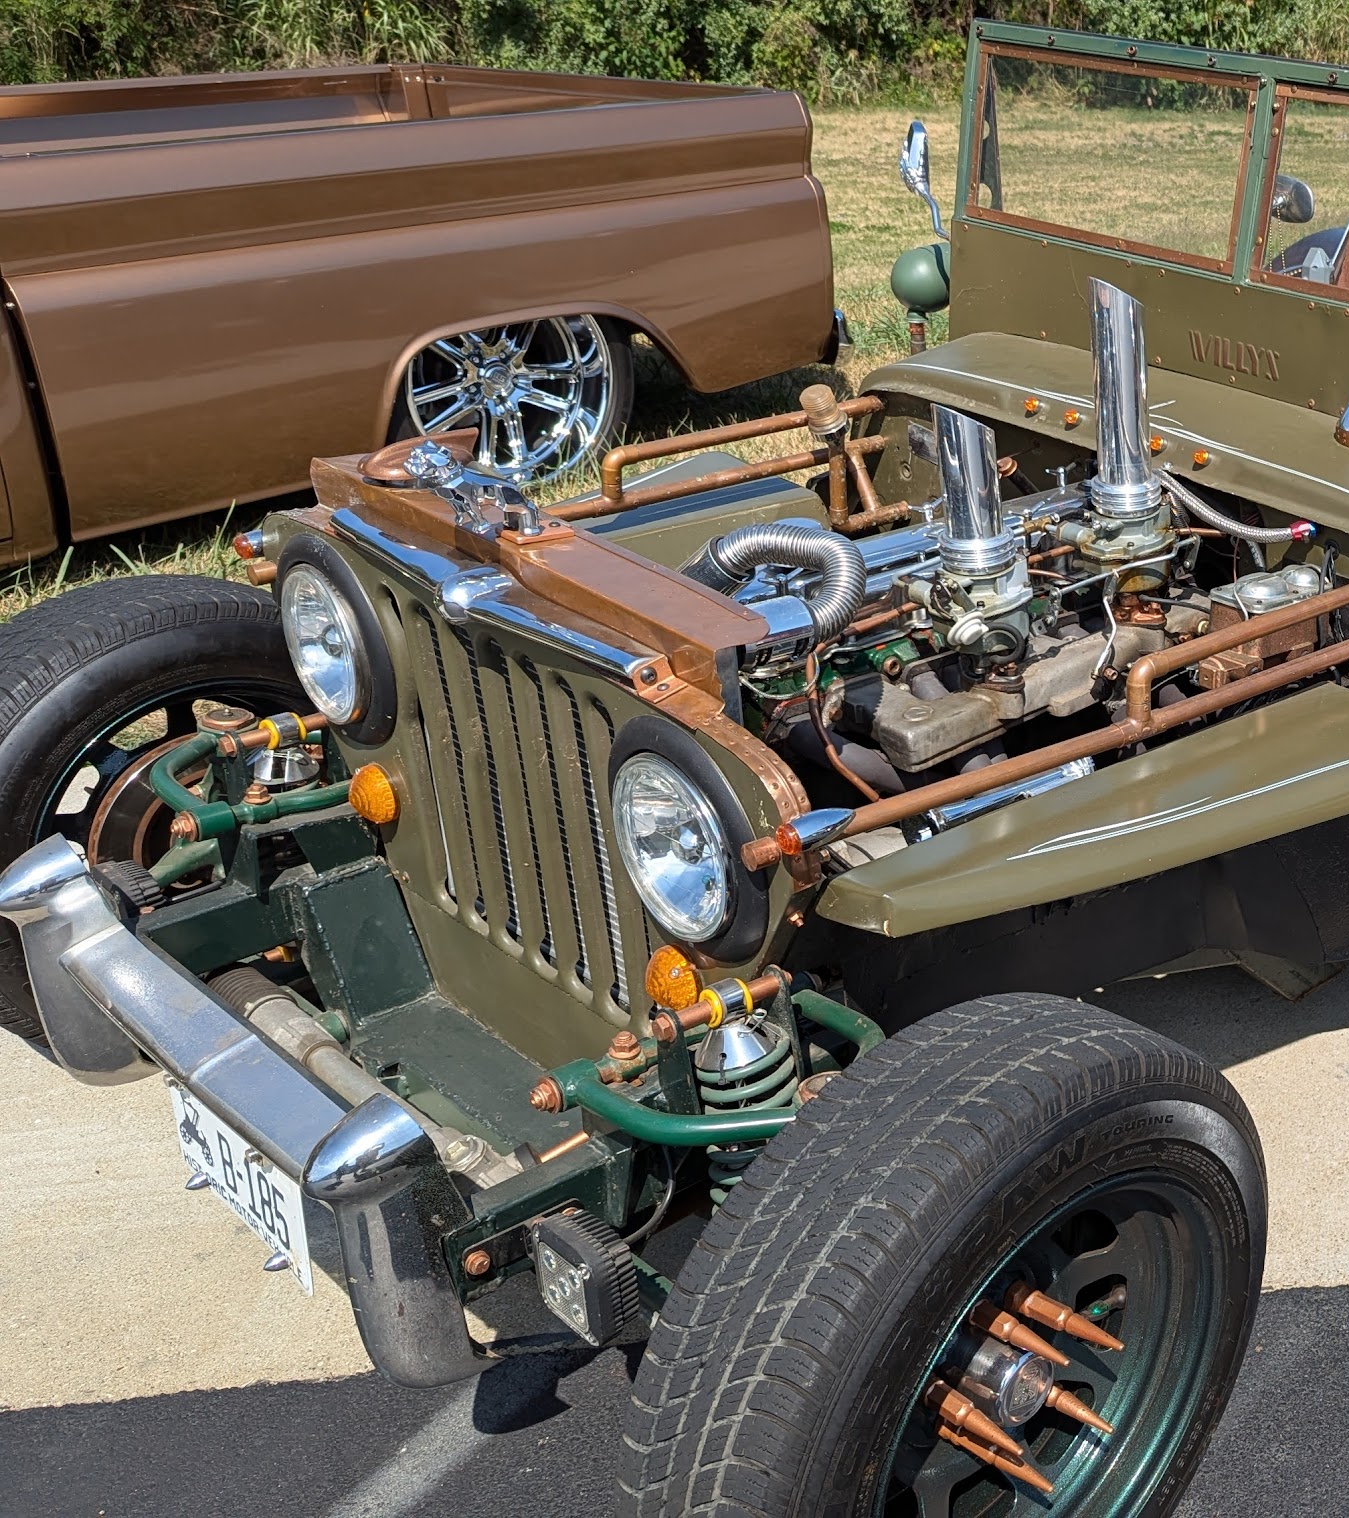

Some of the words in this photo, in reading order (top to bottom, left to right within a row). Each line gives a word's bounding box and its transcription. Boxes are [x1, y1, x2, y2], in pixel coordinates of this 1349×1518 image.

[1188, 329, 1280, 382] WILLYS
[183, 1149, 228, 1200] HISORIC
[228, 1193, 260, 1234] MOTOR
[260, 1226, 304, 1286] VEHCLE
[217, 1130, 290, 1250] B-185
[952, 1133, 1086, 1263] PAW
[1101, 1114, 1175, 1139] TOURING
